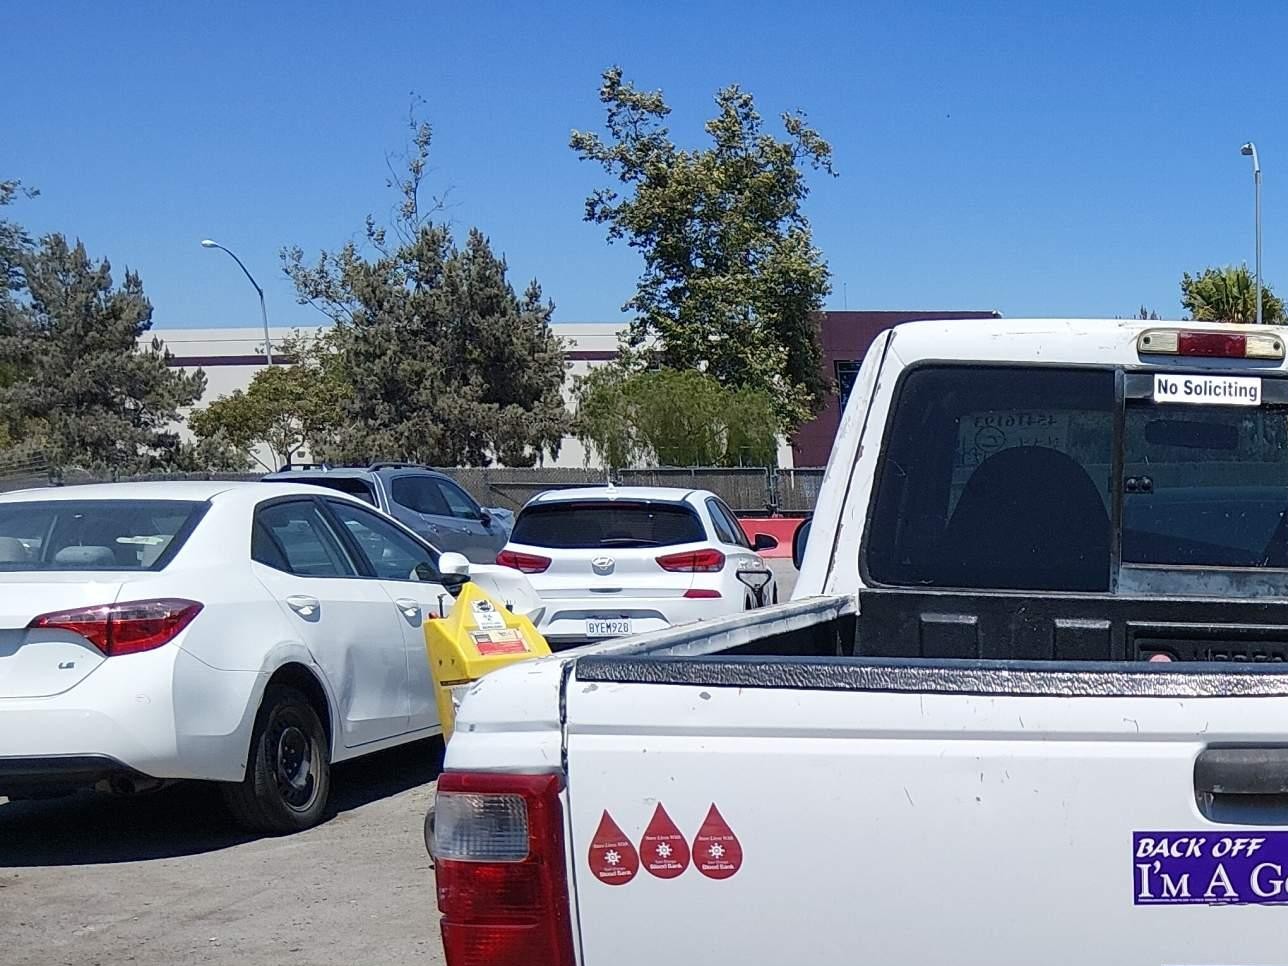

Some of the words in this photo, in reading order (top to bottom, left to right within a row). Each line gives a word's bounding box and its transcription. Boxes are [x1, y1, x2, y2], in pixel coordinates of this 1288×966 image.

[1158, 378, 1178, 394] No
[1184, 380, 1257, 401] Soliciting
[1136, 837, 1206, 858] BACK
[1212, 837, 1266, 858] OFF
[1138, 862, 1190, 898] I'M
[1204, 862, 1239, 898] A
